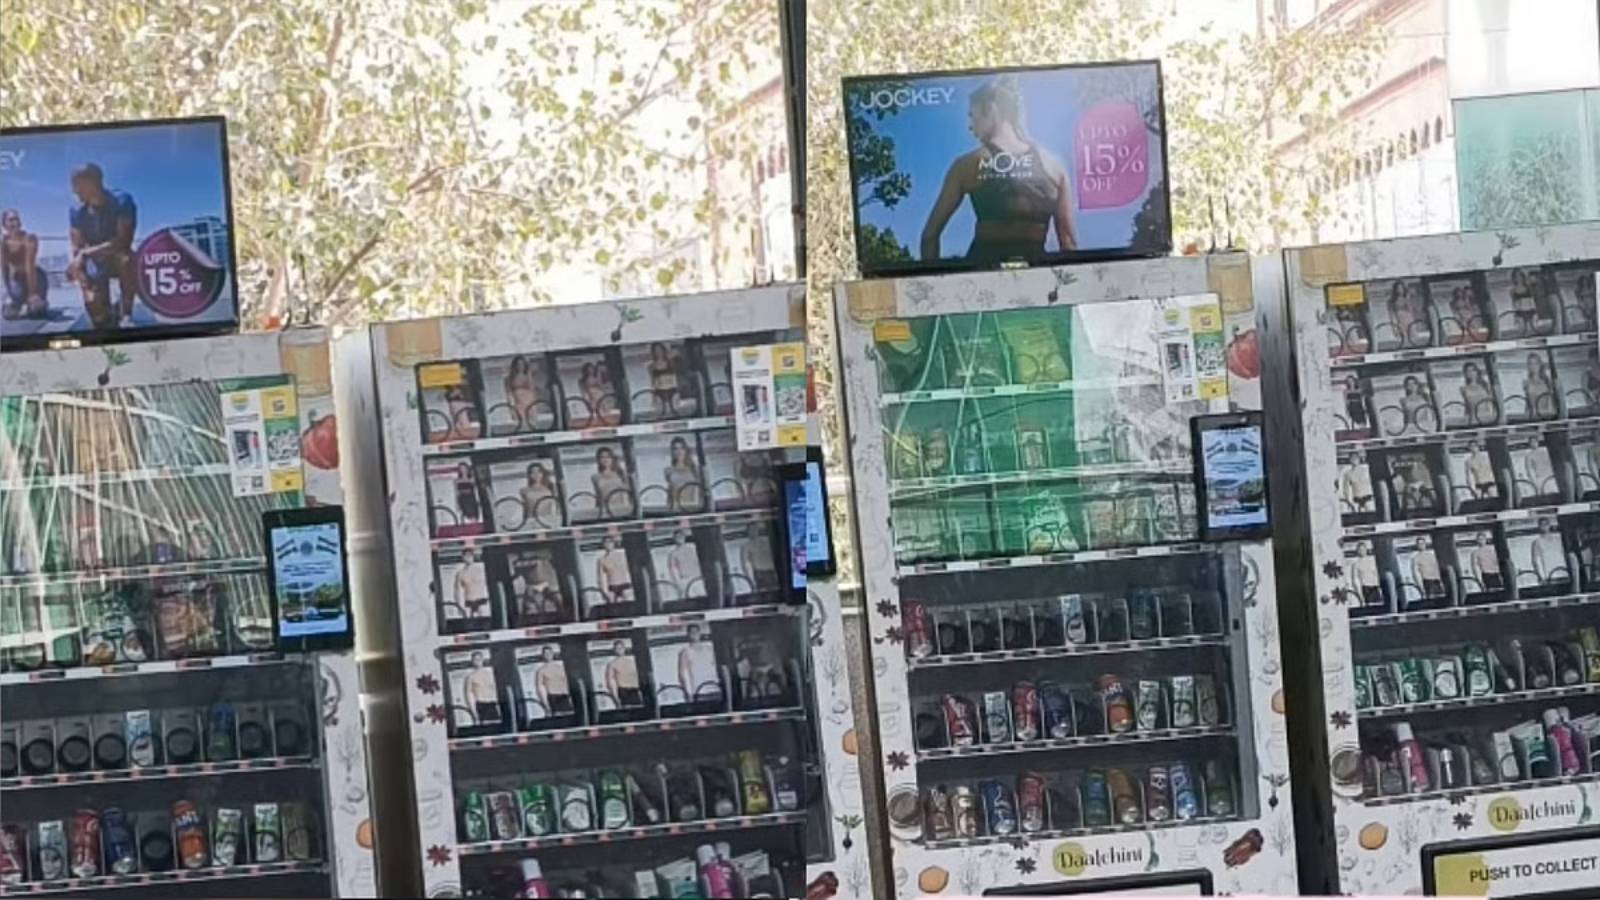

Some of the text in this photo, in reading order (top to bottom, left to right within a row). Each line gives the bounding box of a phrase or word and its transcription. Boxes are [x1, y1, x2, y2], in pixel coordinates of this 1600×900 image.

[860, 87, 954, 109] JOCKEY
[979, 152, 1033, 172] MOVE
[1083, 143, 1144, 175] 15%
[1082, 177, 1112, 191] OFF
[143, 251, 181, 265] UPTO
[1470, 856, 1597, 882] PUSH TO COLLECT
